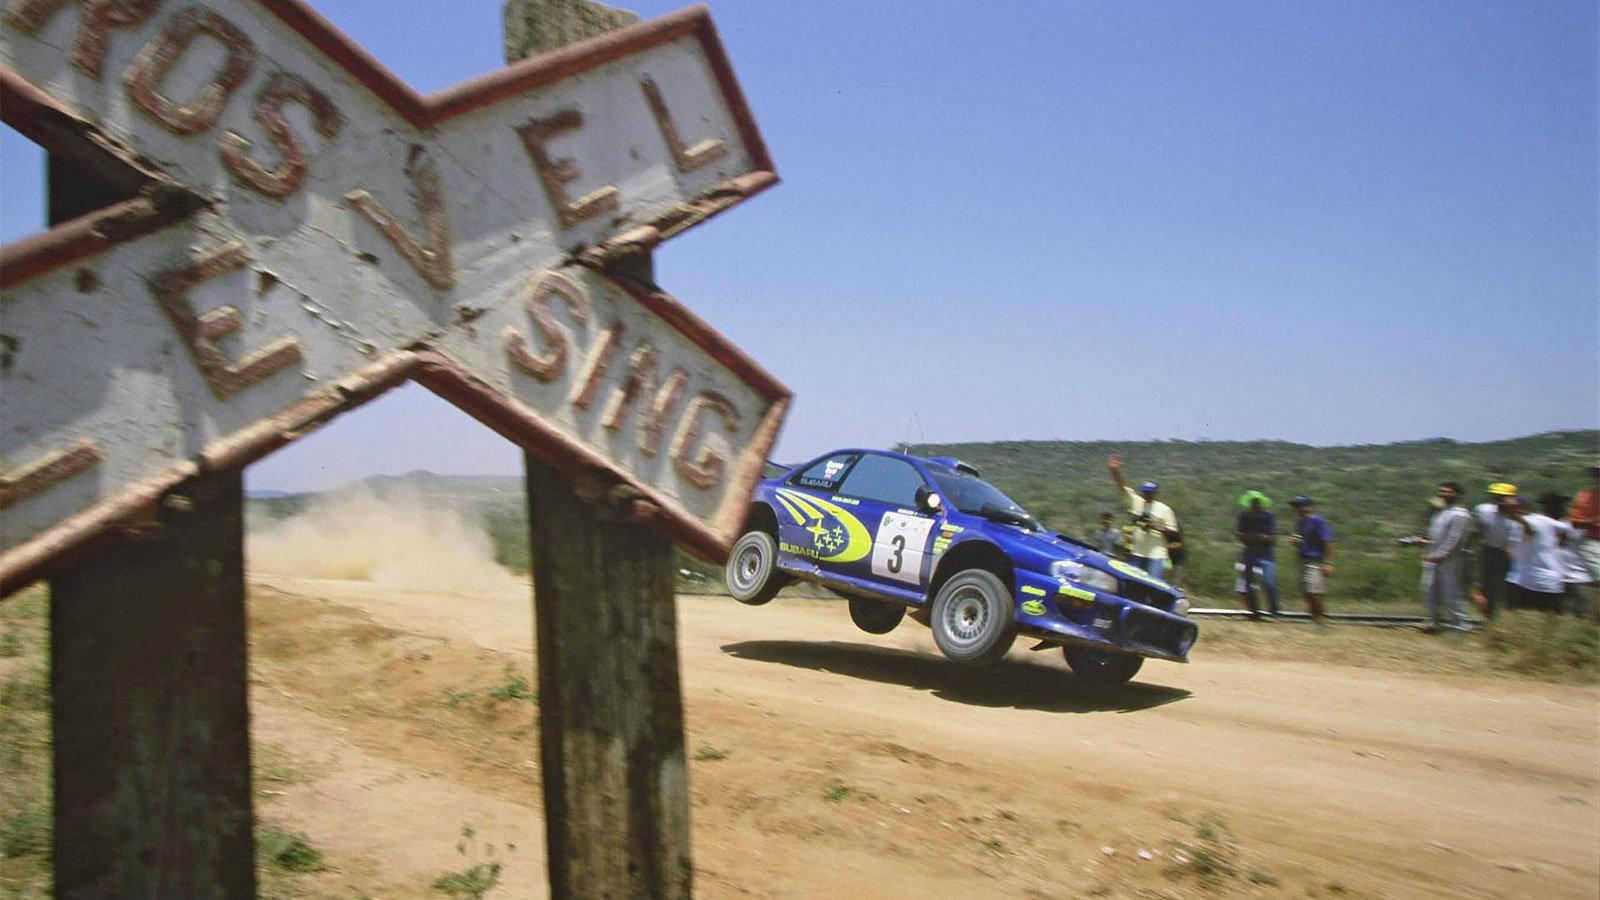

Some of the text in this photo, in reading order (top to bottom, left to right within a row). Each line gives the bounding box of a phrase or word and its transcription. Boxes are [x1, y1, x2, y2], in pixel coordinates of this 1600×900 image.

[800, 477, 833, 488] SUBARU
[779, 542, 819, 559] SUBARU
[887, 535, 906, 574] 3
